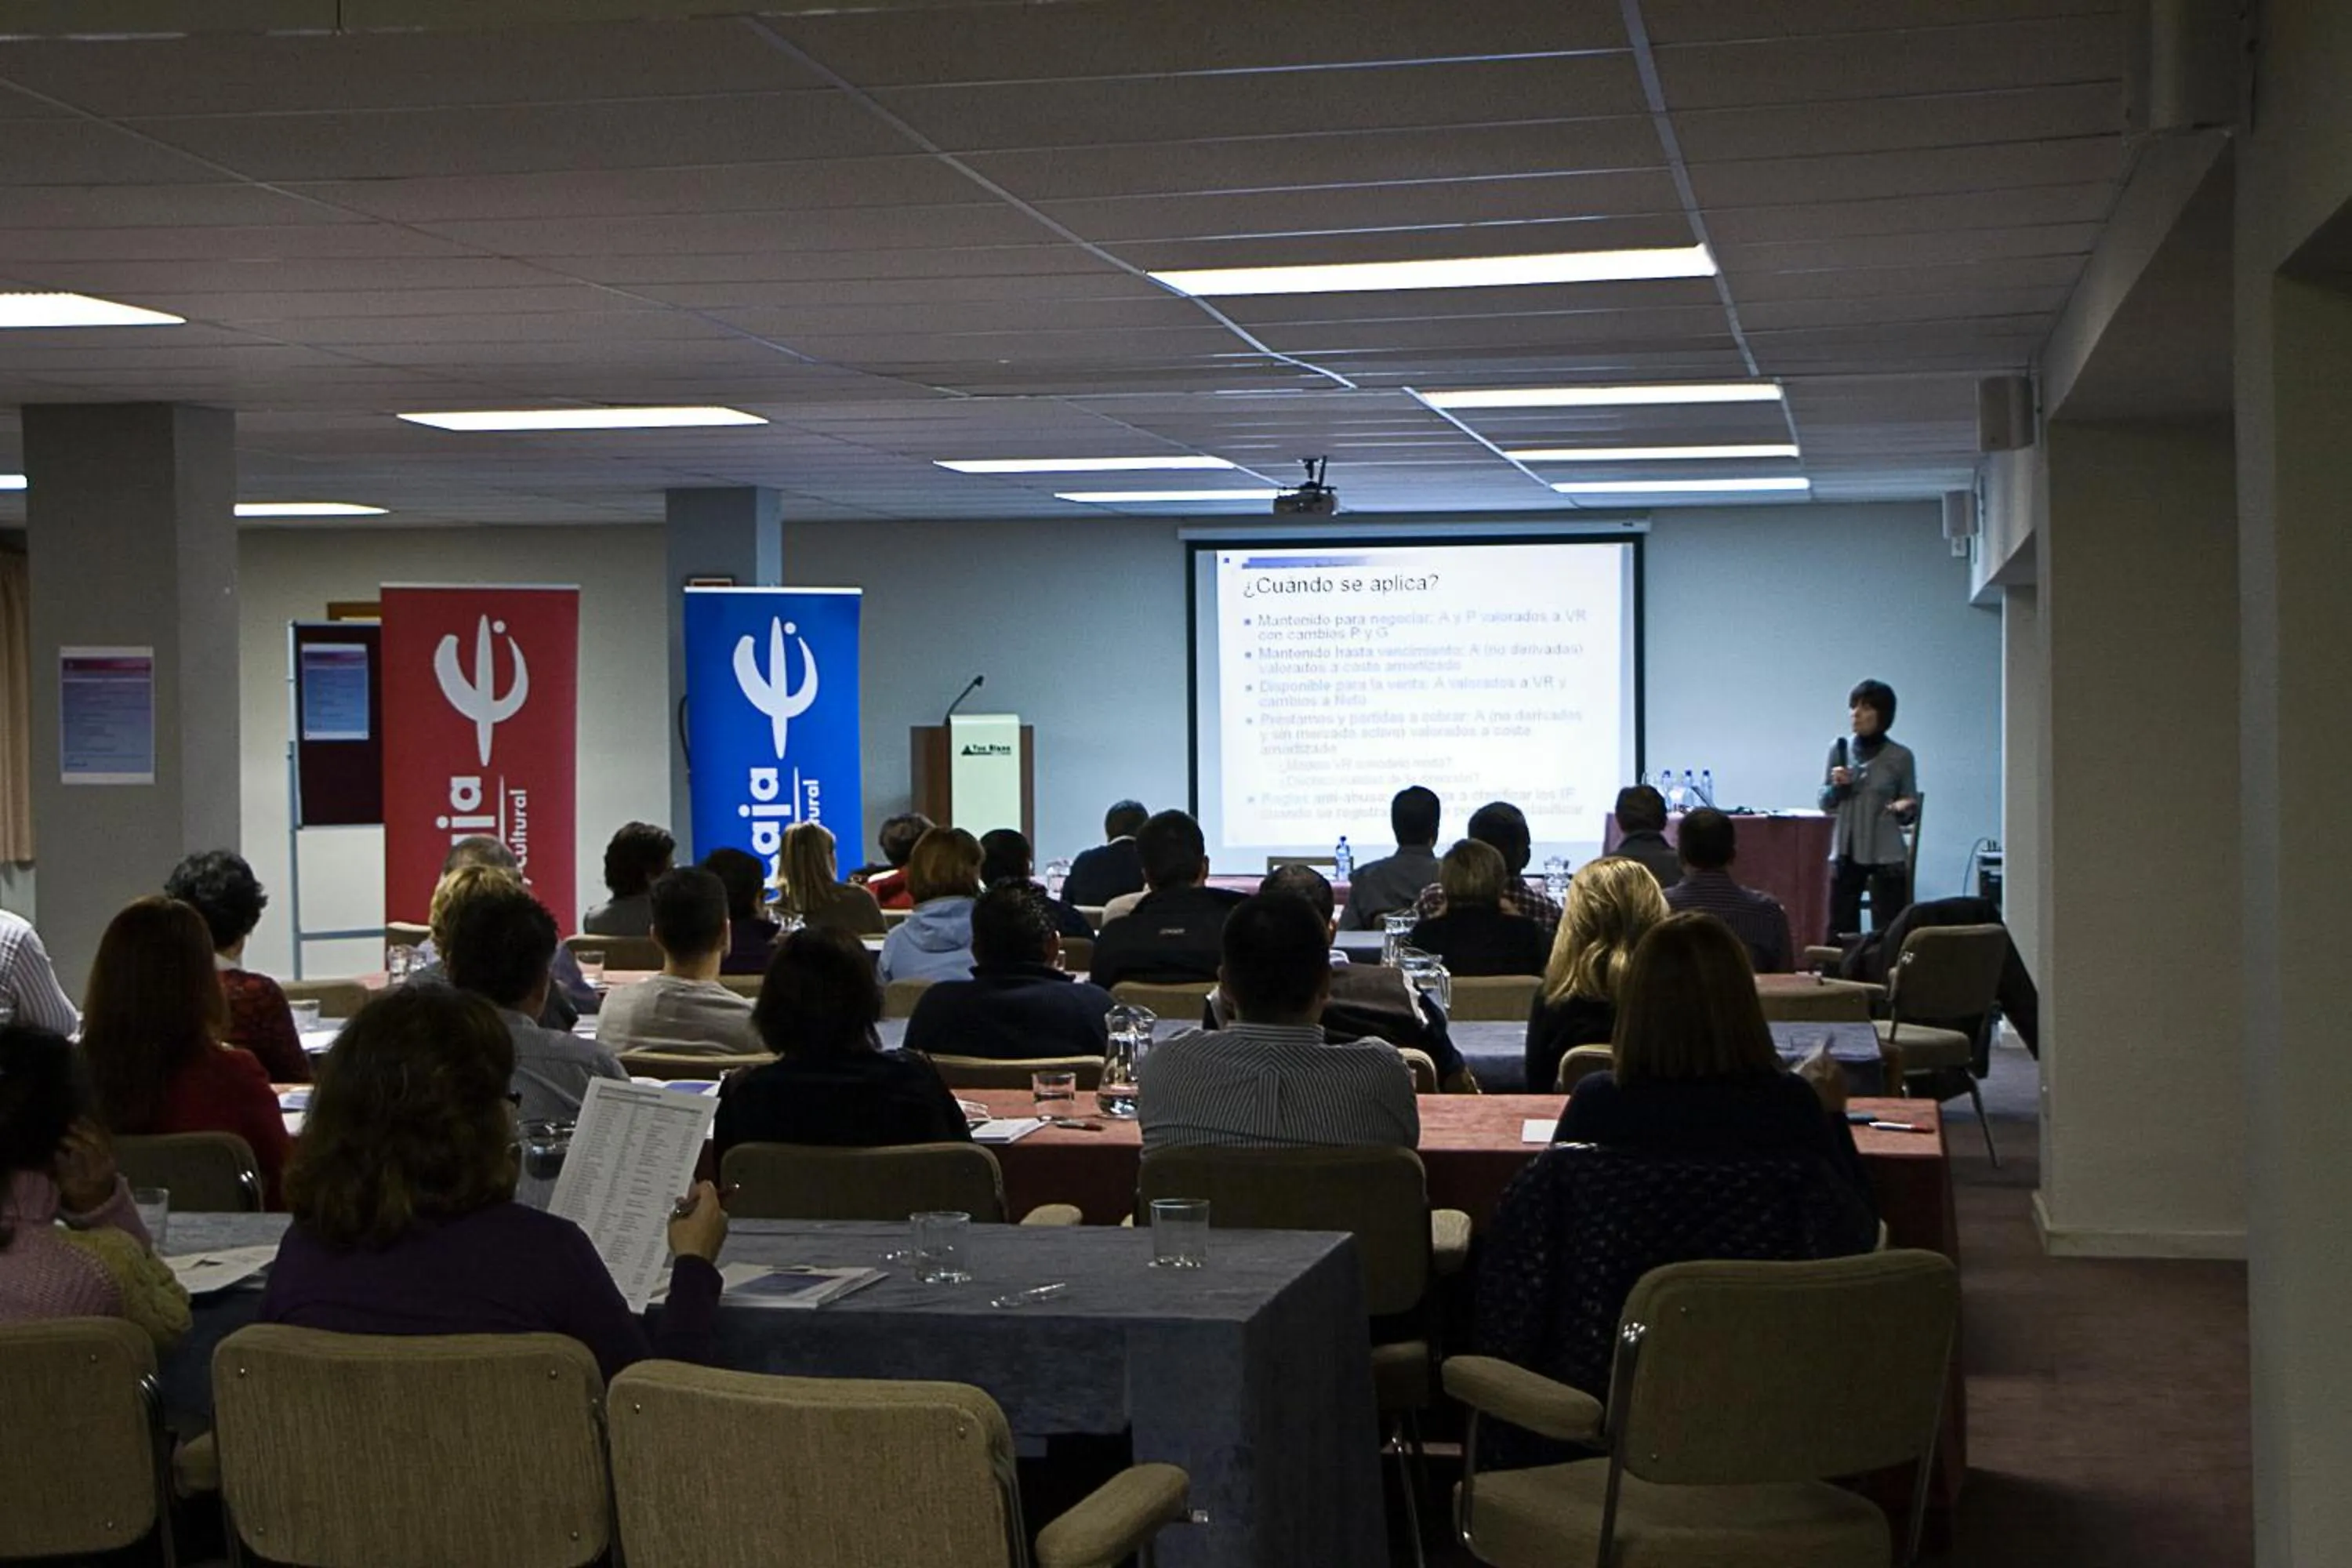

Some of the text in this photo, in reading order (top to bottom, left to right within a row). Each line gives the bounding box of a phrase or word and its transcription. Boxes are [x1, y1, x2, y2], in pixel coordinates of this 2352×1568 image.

[1243, 573, 1440, 598] ¿Cuándo se aplica?
[1258, 614, 1331, 627] Mantenido
[1335, 614, 1366, 628] para
[1565, 608, 1587, 624] VR
